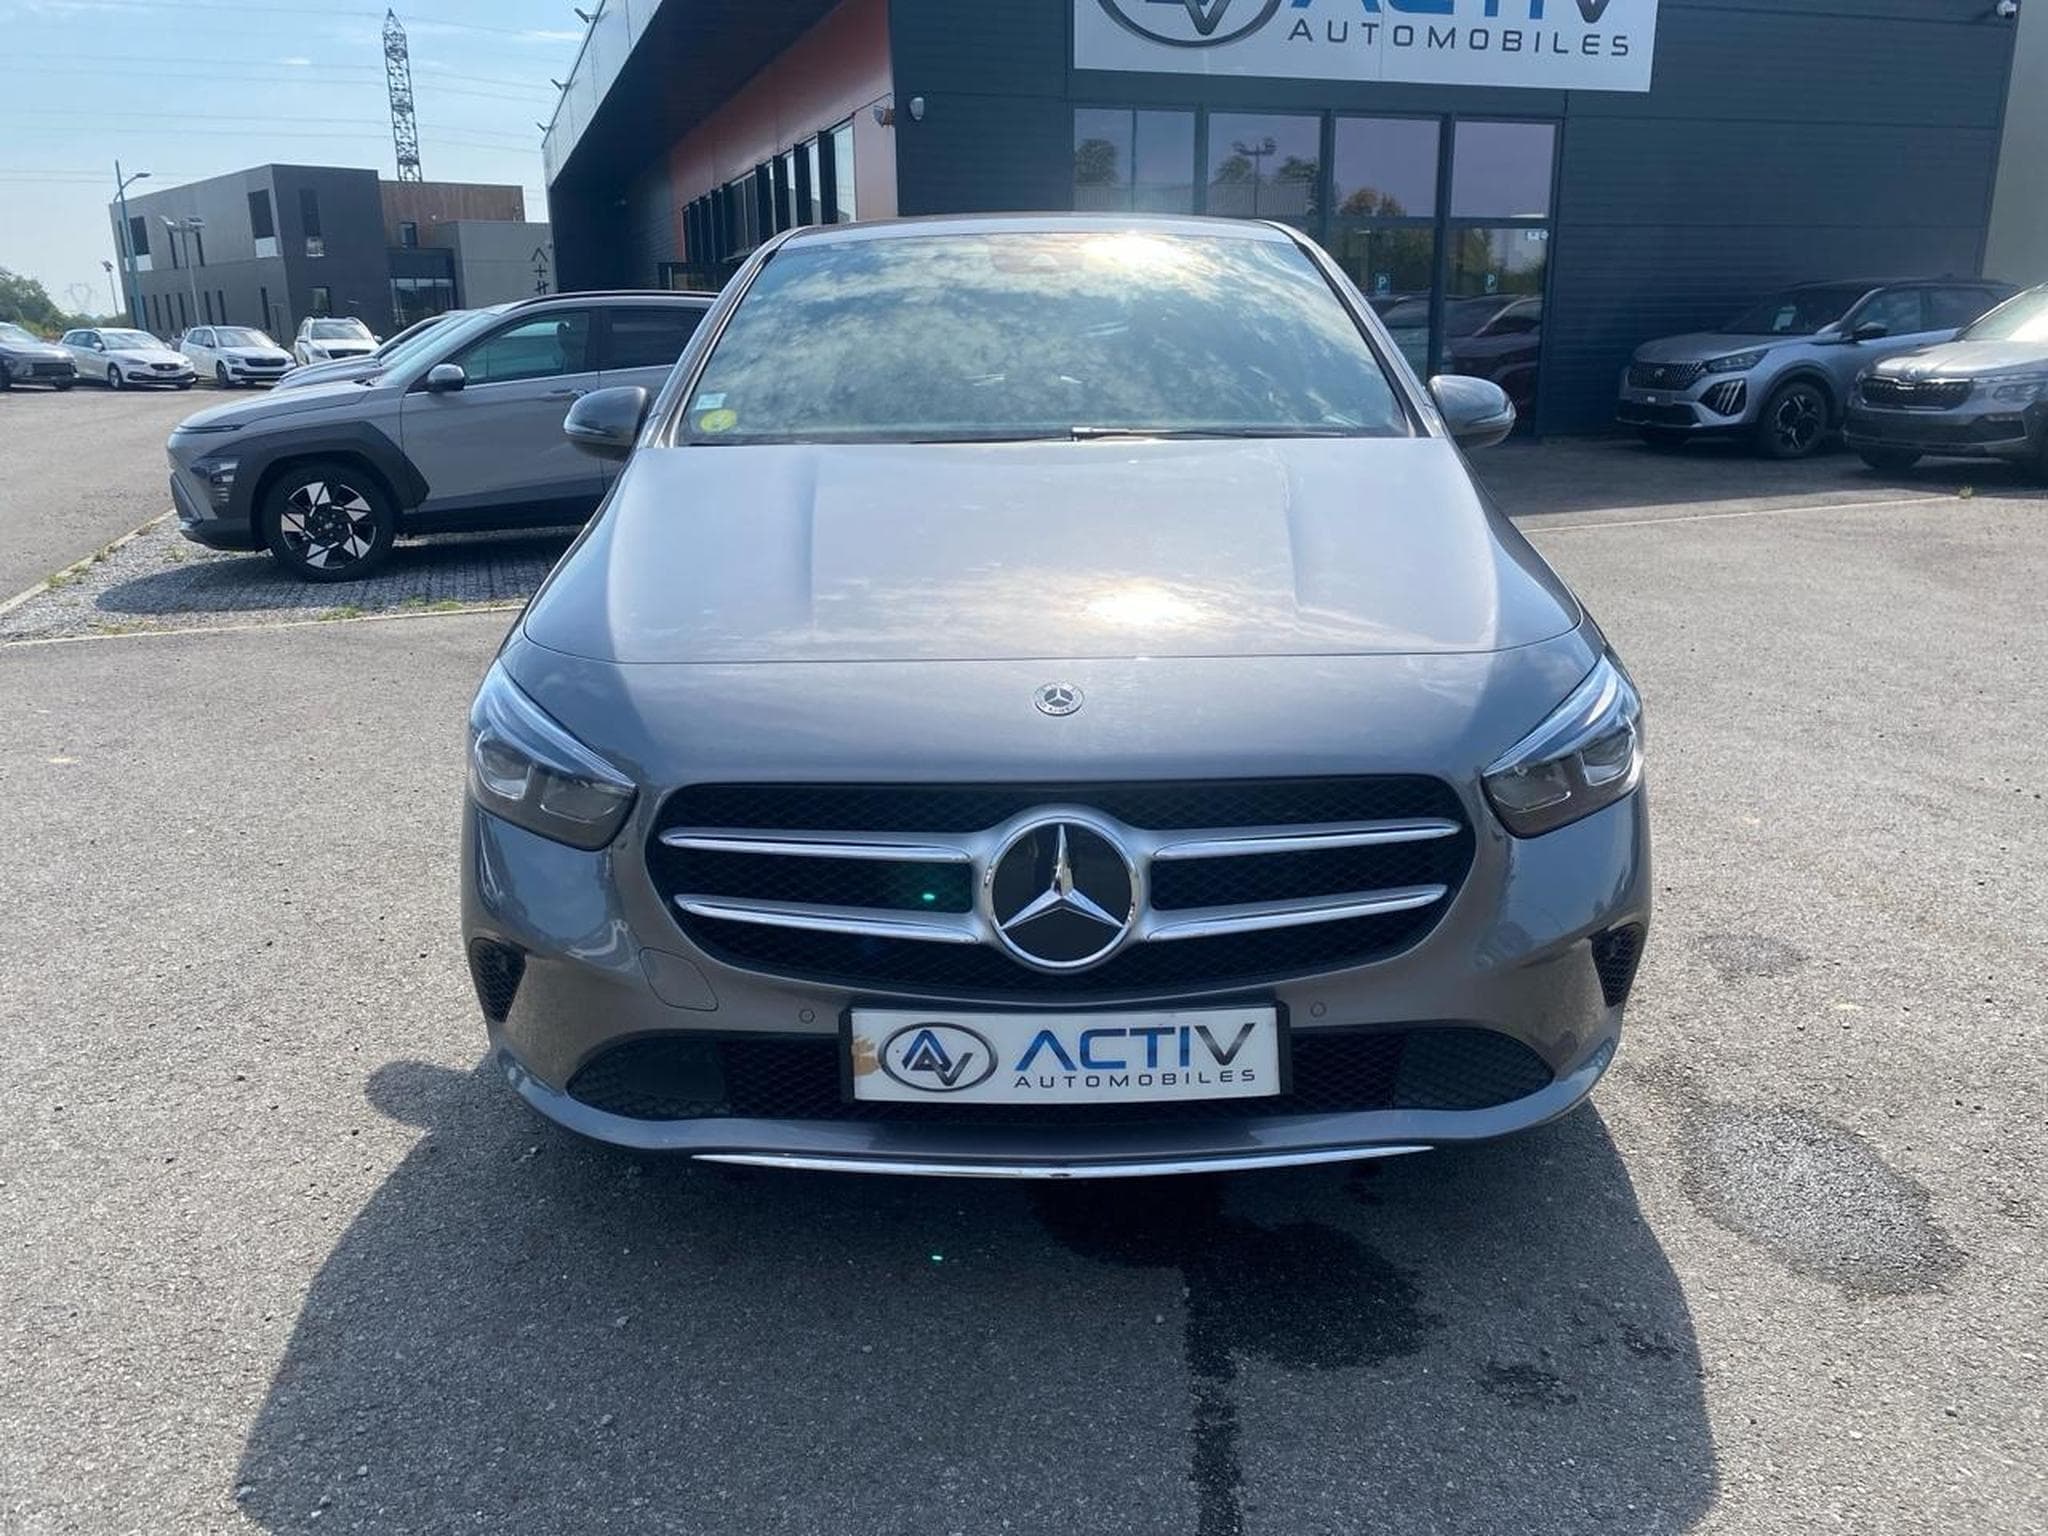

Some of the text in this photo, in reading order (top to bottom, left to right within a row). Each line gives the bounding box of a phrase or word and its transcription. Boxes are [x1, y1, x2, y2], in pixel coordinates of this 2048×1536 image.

[1287, 17, 1629, 57] AUTOMOBILES
[1014, 1022, 1256, 1072] ACTIV
[1014, 1069, 1256, 1089] AUTOMOBILES
